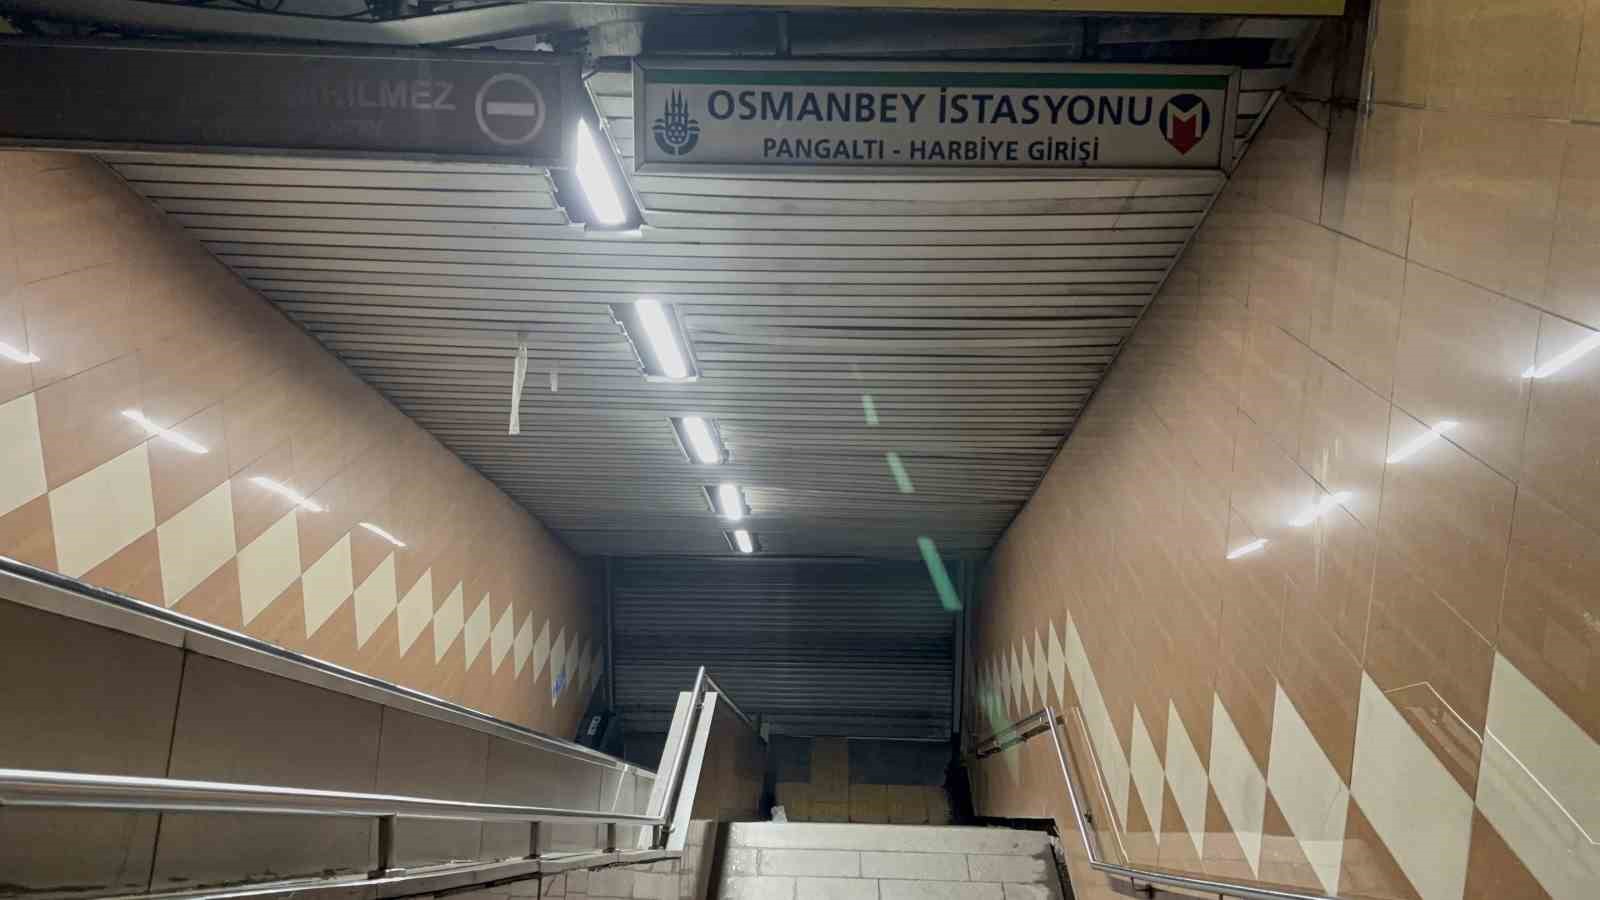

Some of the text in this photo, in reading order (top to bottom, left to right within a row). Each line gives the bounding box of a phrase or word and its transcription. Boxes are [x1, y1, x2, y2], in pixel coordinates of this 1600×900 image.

[707, 89, 925, 124] OSMANBEY
[938, 88, 1153, 126] İSTASYONU
[763, 137, 885, 160] PANGALTI
[910, 136, 1019, 161] HARBİYE
[1028, 136, 1099, 167] GİRİŞİ
